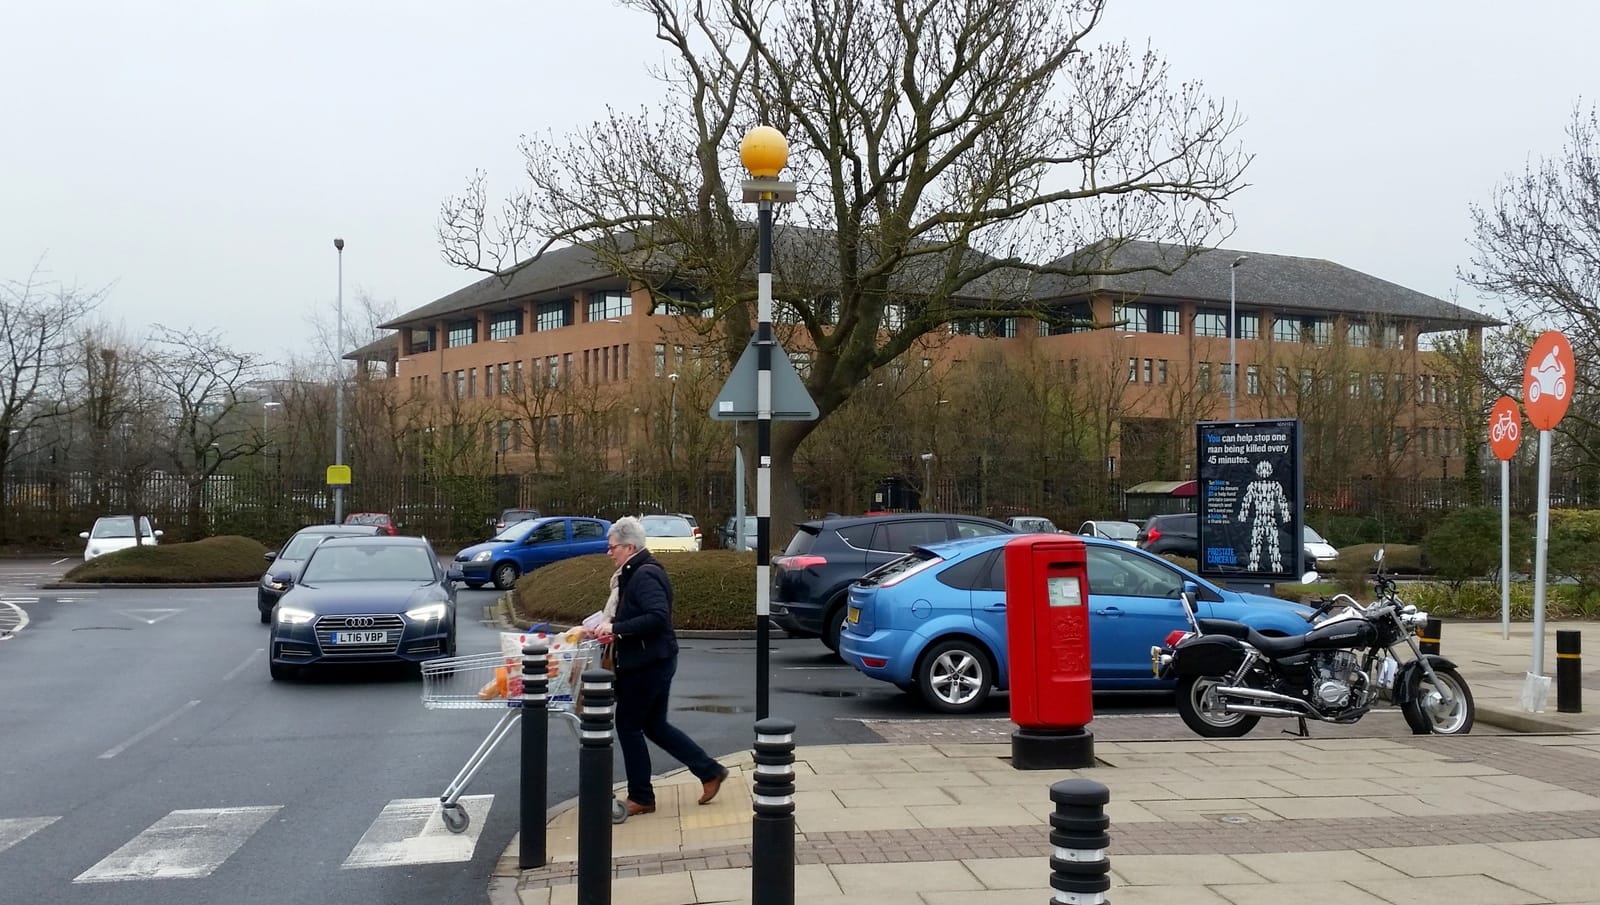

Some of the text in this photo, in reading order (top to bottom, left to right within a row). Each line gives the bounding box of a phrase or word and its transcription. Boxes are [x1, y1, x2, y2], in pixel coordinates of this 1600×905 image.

[1207, 434, 1221, 443] You
[1237, 434, 1252, 443] help
[1254, 434, 1270, 442] stop
[1224, 445, 1244, 454] being
[1246, 444, 1266, 452] killed
[1267, 445, 1288, 453] every
[1208, 456, 1249, 464] 45 minutes.
[1208, 547, 1234, 556] PROSTATE
[1208, 555, 1229, 564] CANCER
[340, 632, 383, 642] LT16 VBP
